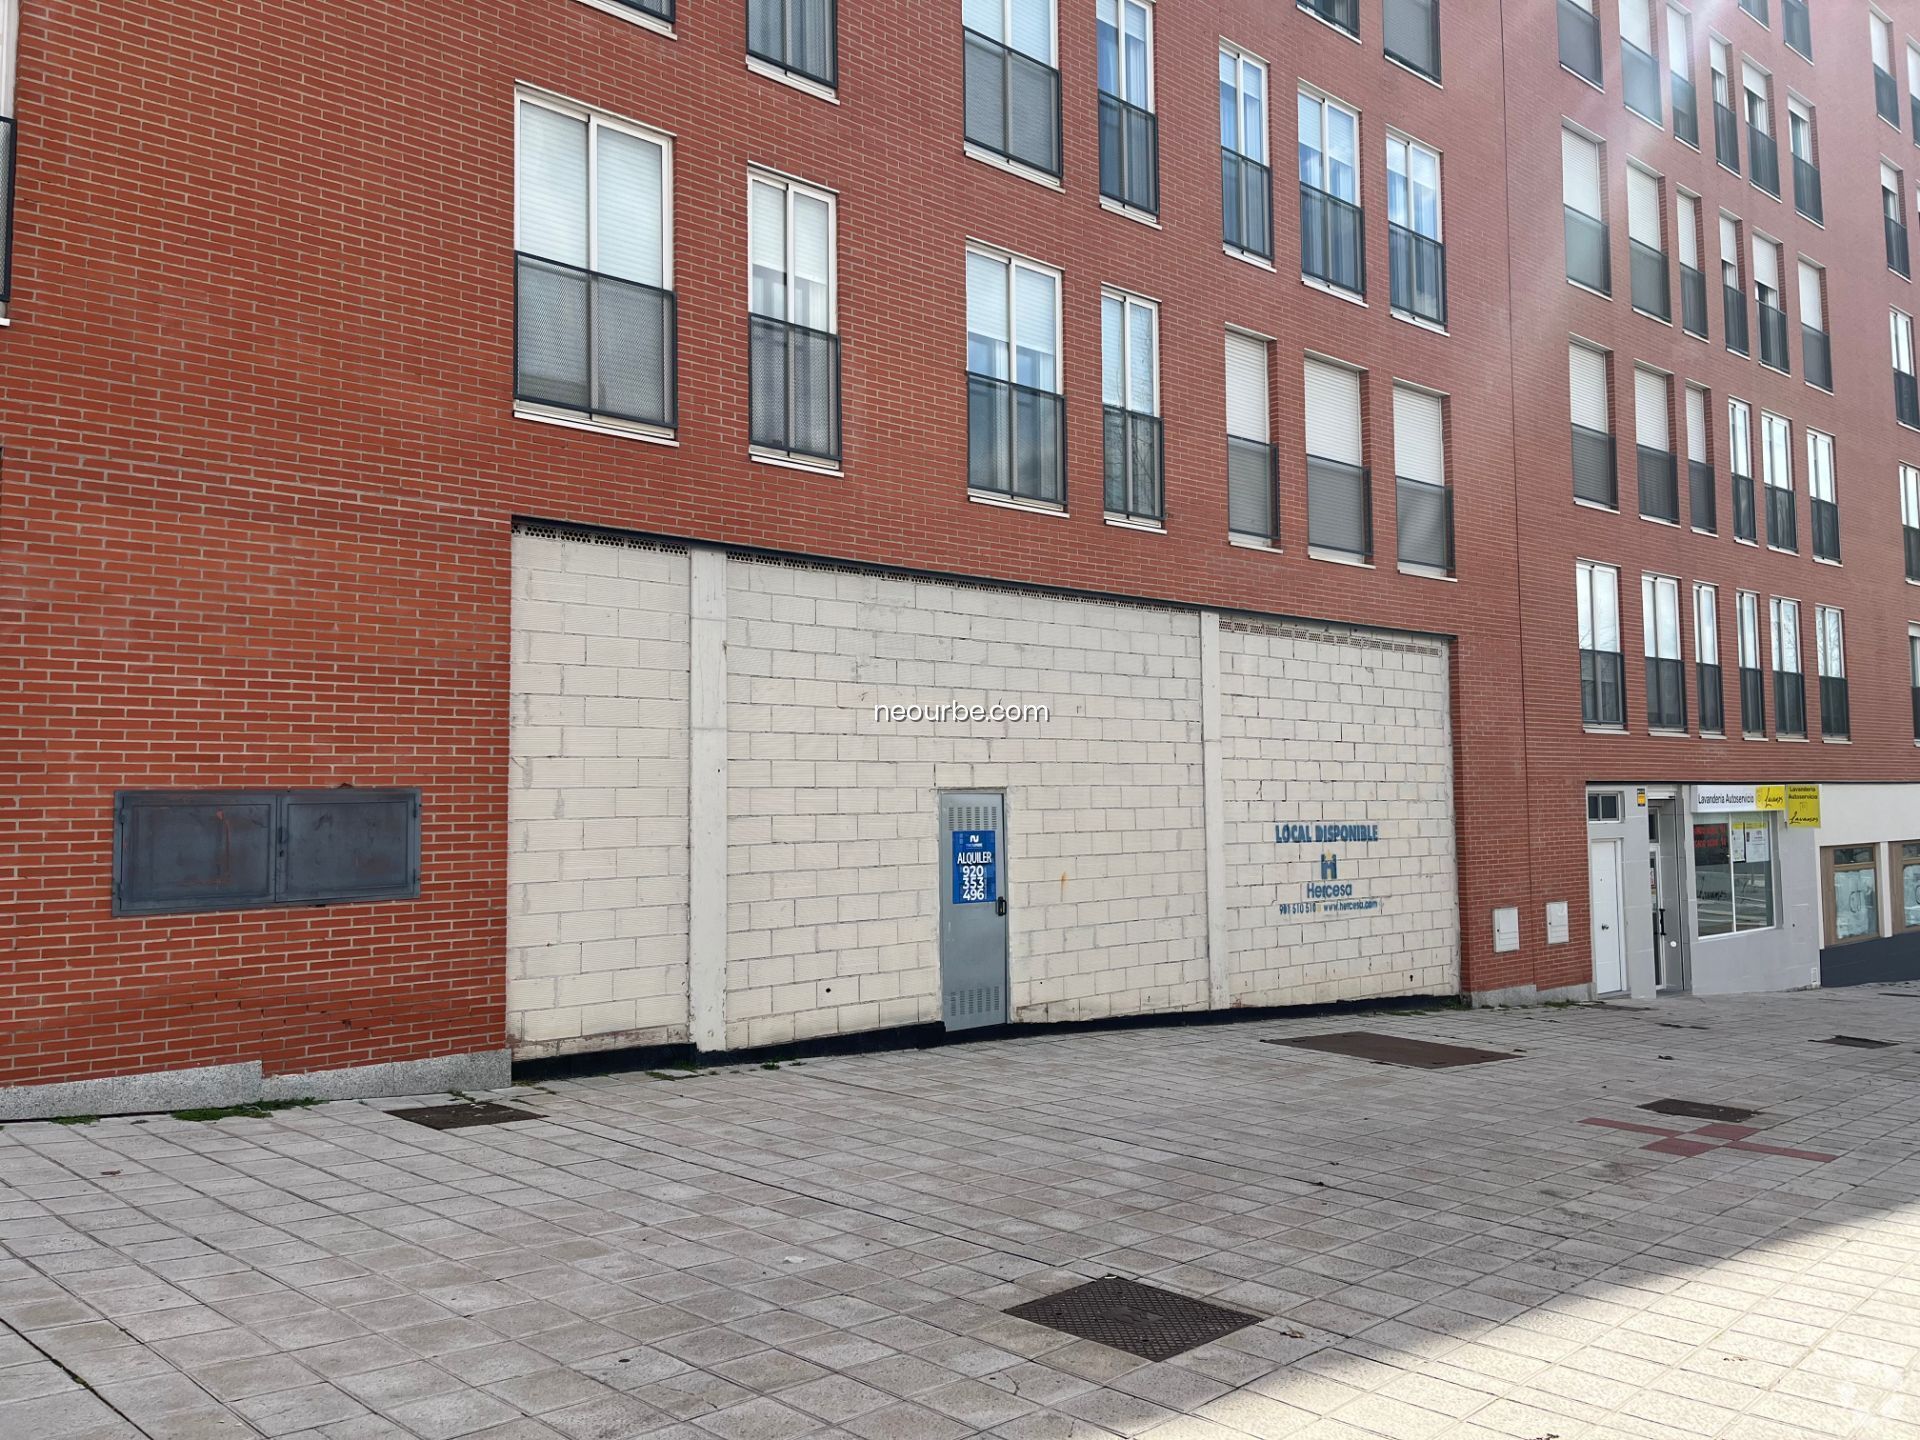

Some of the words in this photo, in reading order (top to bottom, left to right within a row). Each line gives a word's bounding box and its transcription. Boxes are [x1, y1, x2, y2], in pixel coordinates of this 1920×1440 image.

[1275, 825, 1311, 843] LOCAL
[1316, 824, 1379, 842] DISPONIBLE
[957, 851, 992, 864] ALQUILER
[962, 865, 984, 878] 920
[962, 877, 984, 889] 353
[963, 889, 985, 901] 496
[1307, 883, 1352, 899] Hercesa
